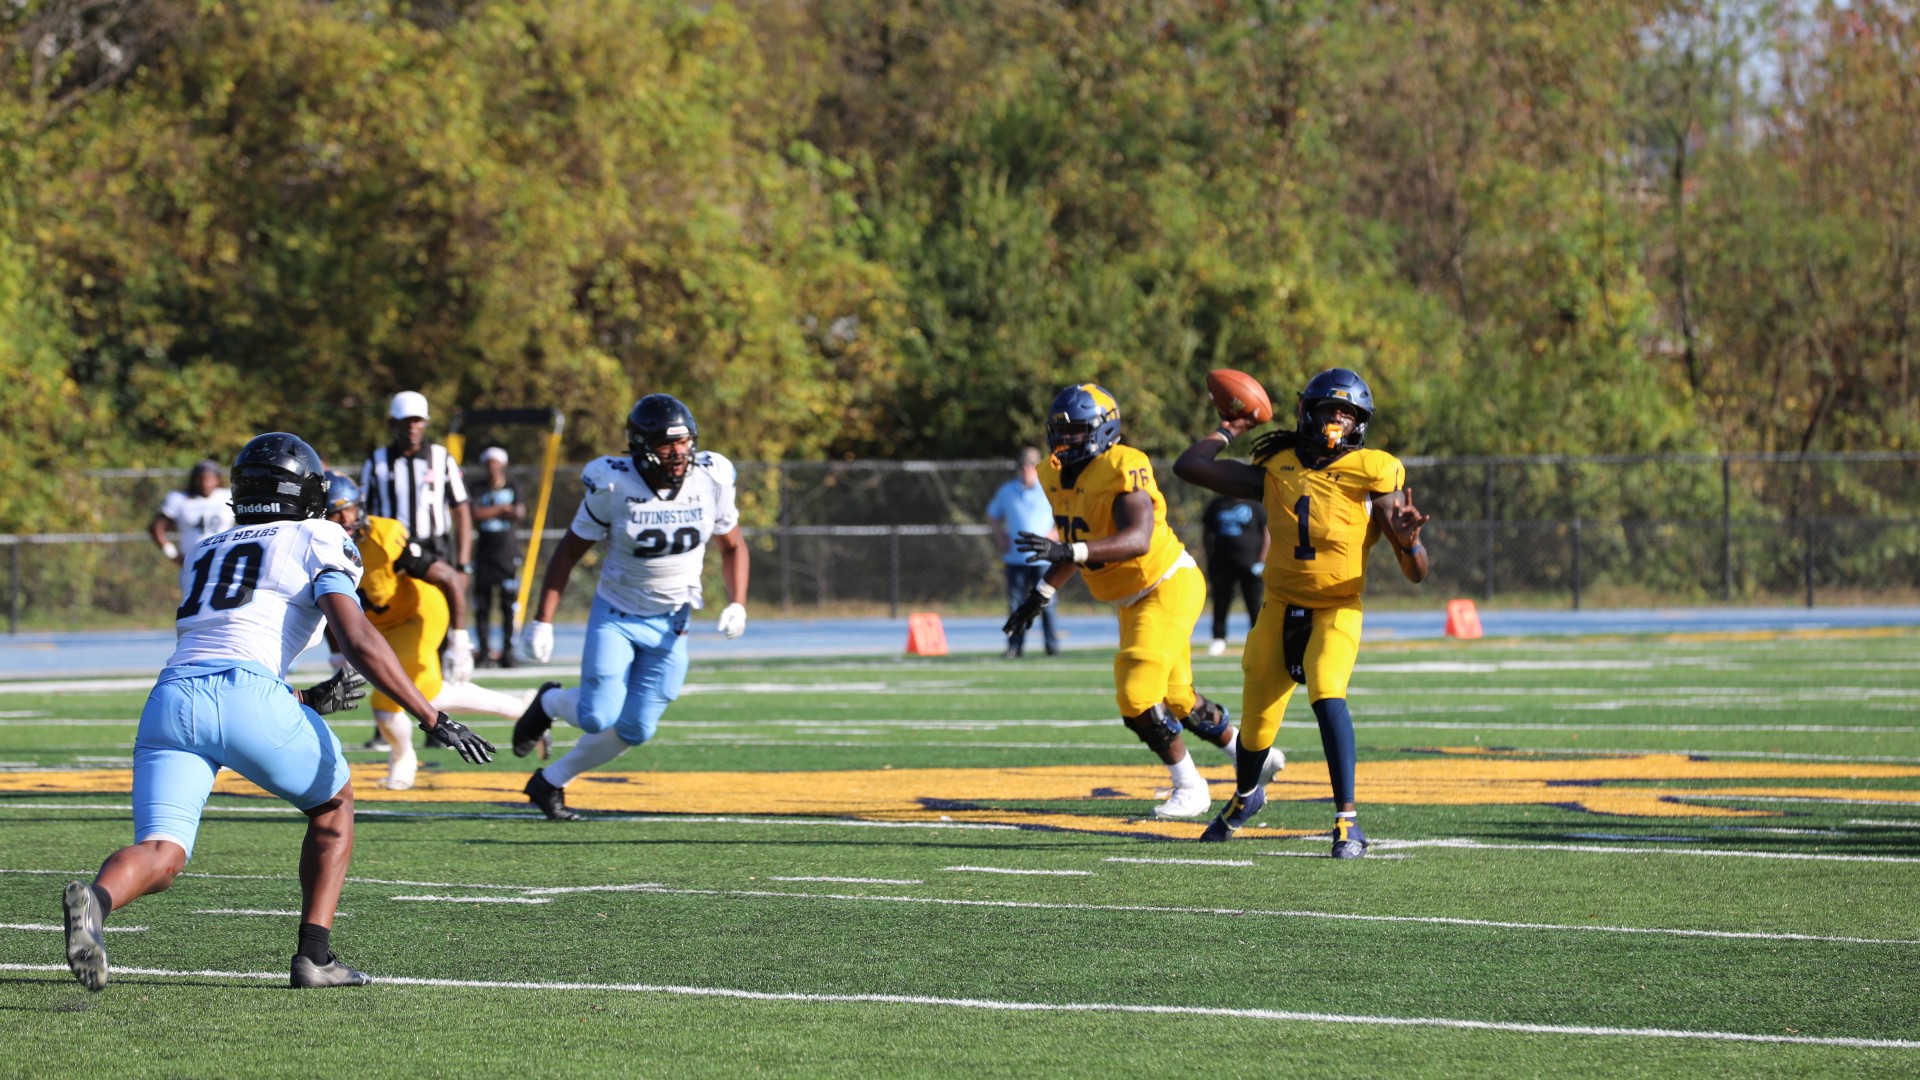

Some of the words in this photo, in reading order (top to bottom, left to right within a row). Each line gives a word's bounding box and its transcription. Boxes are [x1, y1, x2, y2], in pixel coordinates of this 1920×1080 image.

[1129, 467, 1149, 492] 76
[236, 502, 280, 514] Riddell
[631, 508, 703, 524] LIVINGSTONE
[232, 527, 279, 541] BEARS
[1294, 495, 1316, 560] 1
[633, 526, 701, 558] 20
[176, 541, 264, 620] 10
